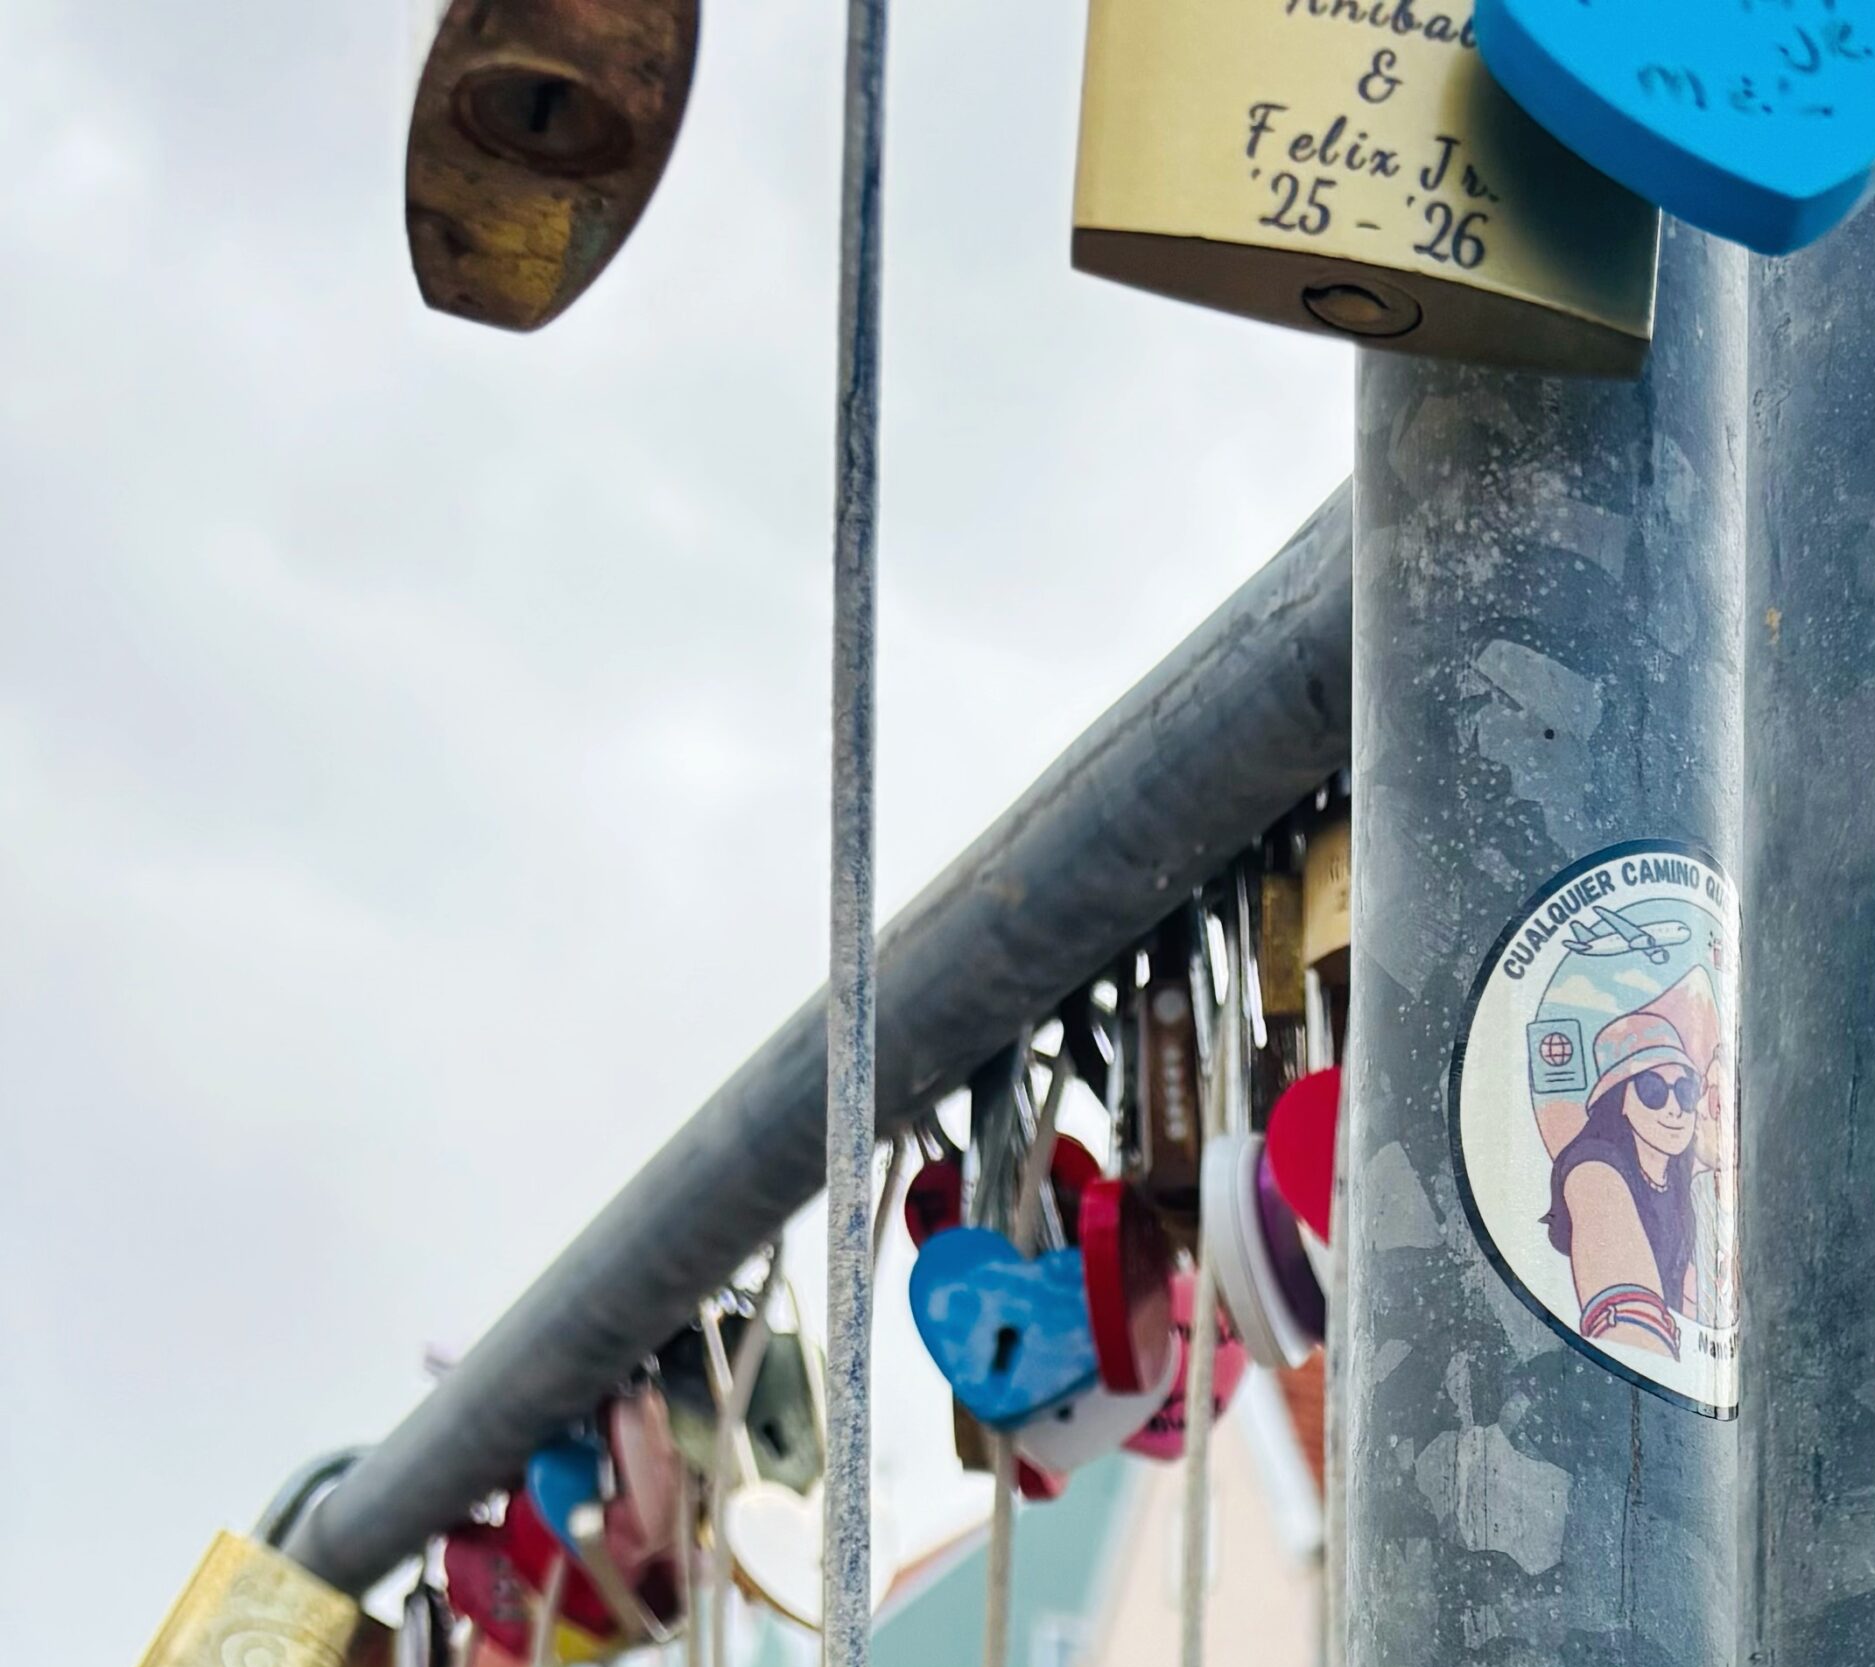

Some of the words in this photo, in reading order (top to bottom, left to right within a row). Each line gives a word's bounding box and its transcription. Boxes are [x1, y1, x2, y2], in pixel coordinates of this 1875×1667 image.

[1358, 49, 1403, 103] &
[1246, 103, 1400, 177] Felix
[1420, 135, 1499, 203] Jr.
[1503, 869, 1616, 980] CUALQUIER
[1621, 859, 1700, 889] CAMINO
